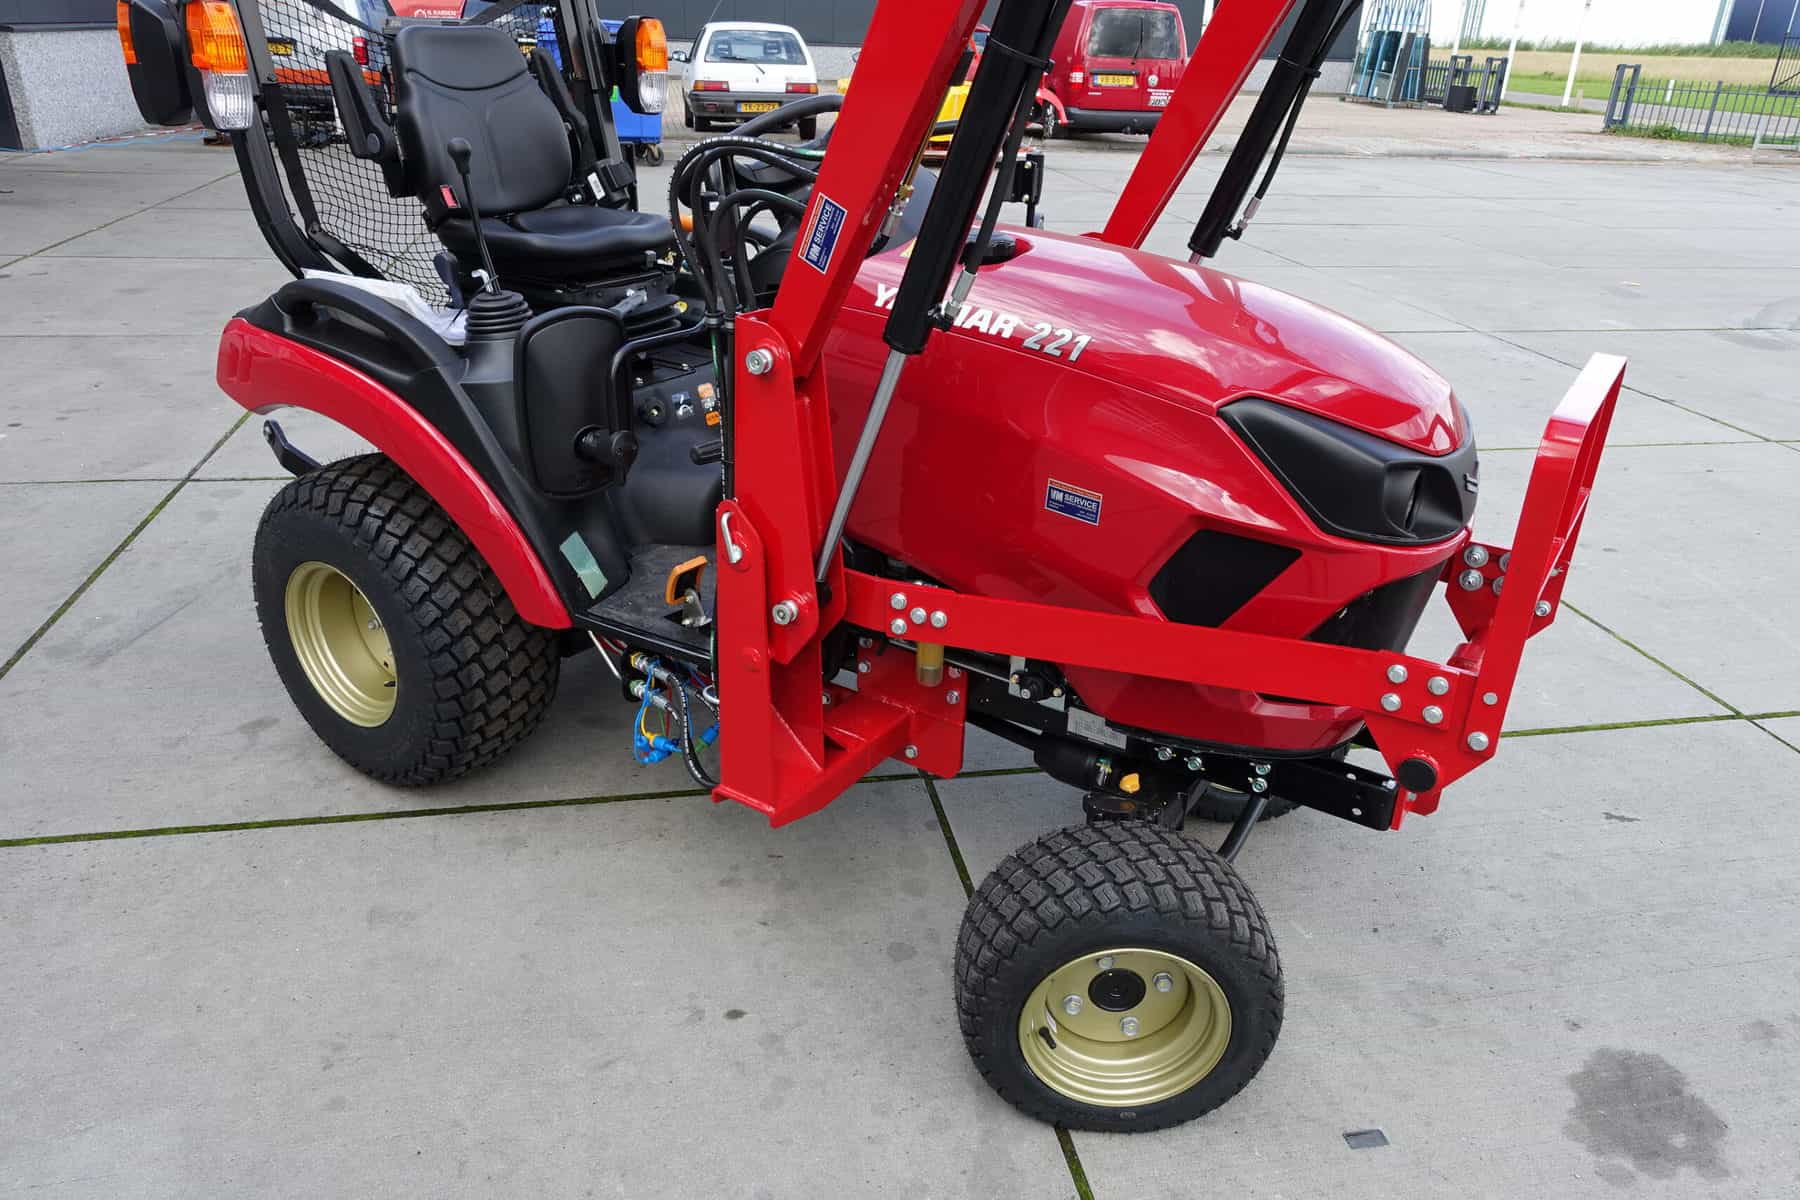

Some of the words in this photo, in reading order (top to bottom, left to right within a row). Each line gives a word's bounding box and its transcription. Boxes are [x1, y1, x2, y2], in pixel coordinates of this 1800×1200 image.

[814, 202, 833, 245] SERVICE
[874, 283, 1020, 338] YAR
[1022, 322, 1096, 362] 221
[1064, 493, 1098, 510] SERVICE
